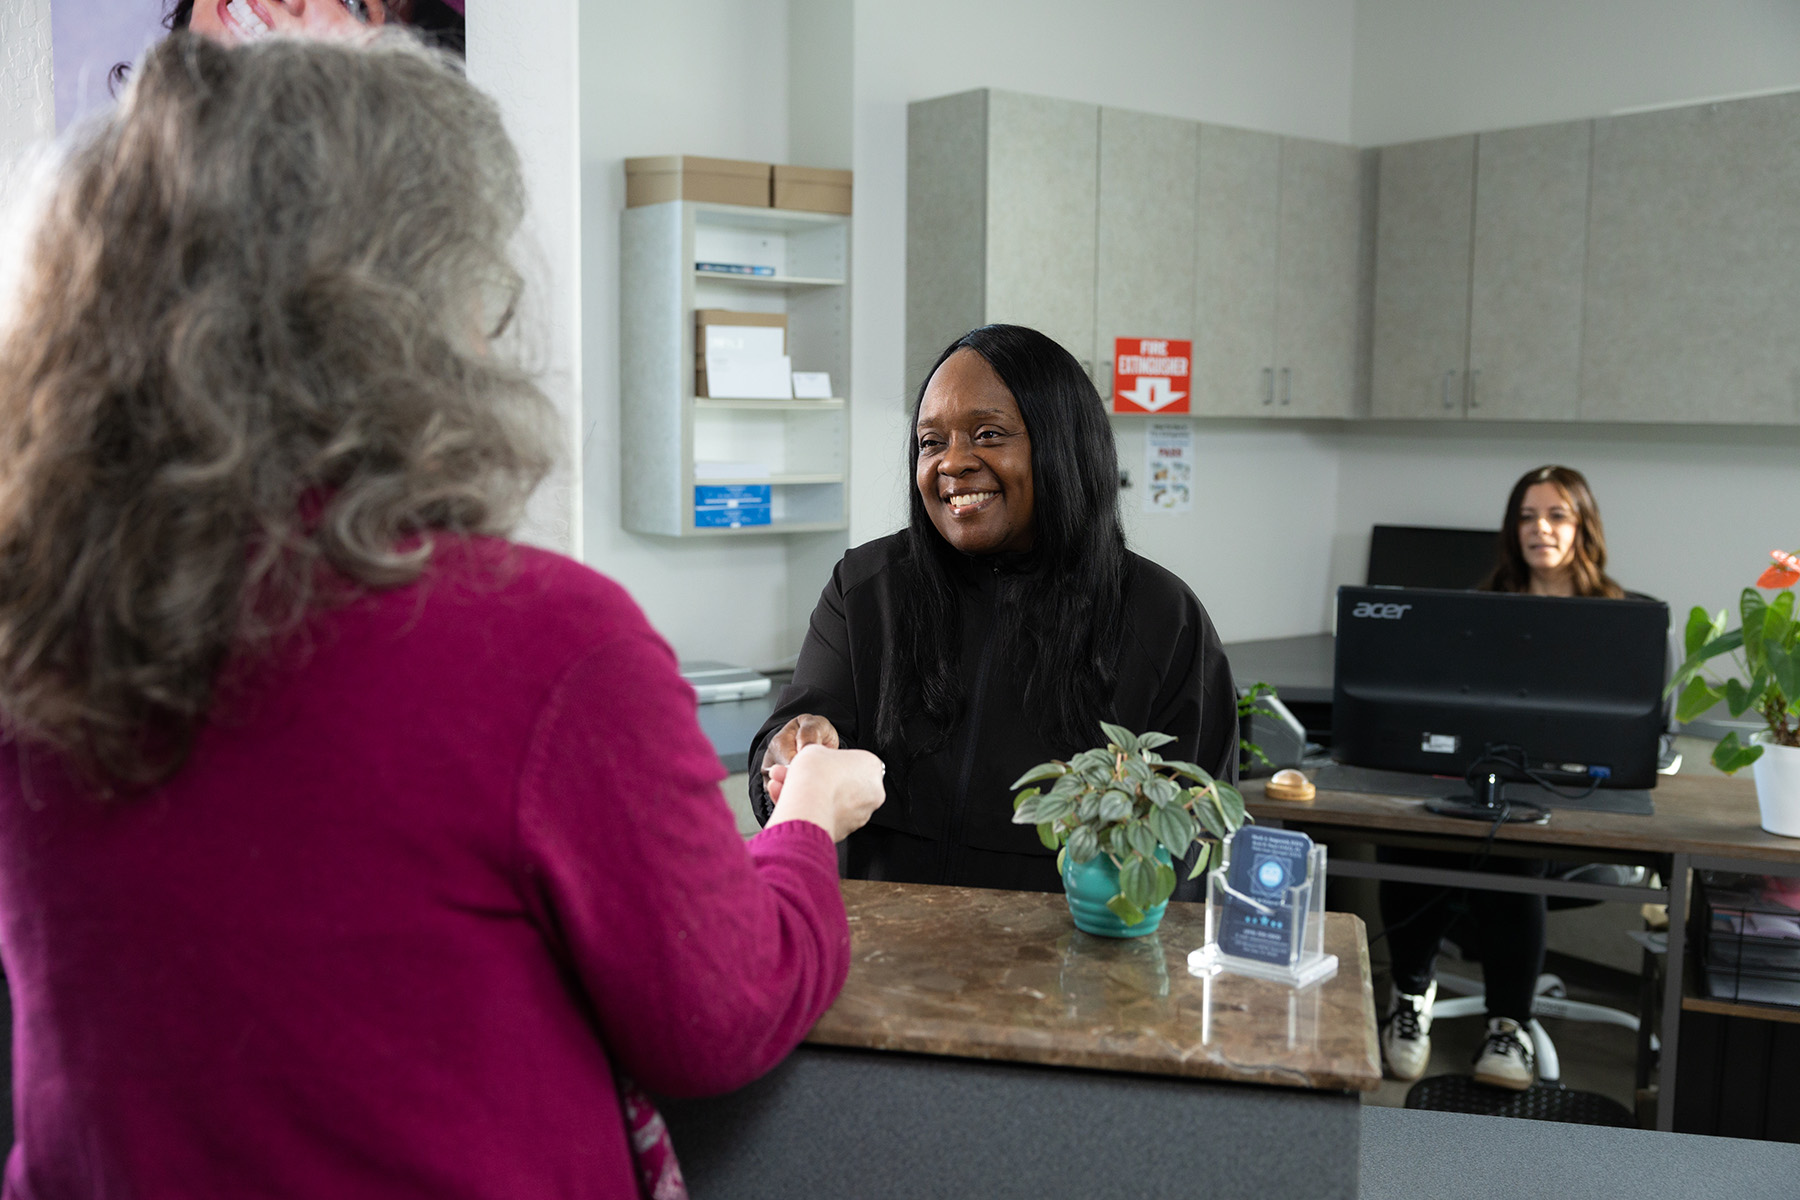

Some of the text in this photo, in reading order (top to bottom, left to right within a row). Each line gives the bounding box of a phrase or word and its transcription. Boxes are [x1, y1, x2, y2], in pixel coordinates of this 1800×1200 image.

[1140, 340, 1169, 356] FIRE
[1118, 354, 1188, 377] EXTINGUISHER
[1352, 602, 1412, 619] acer
